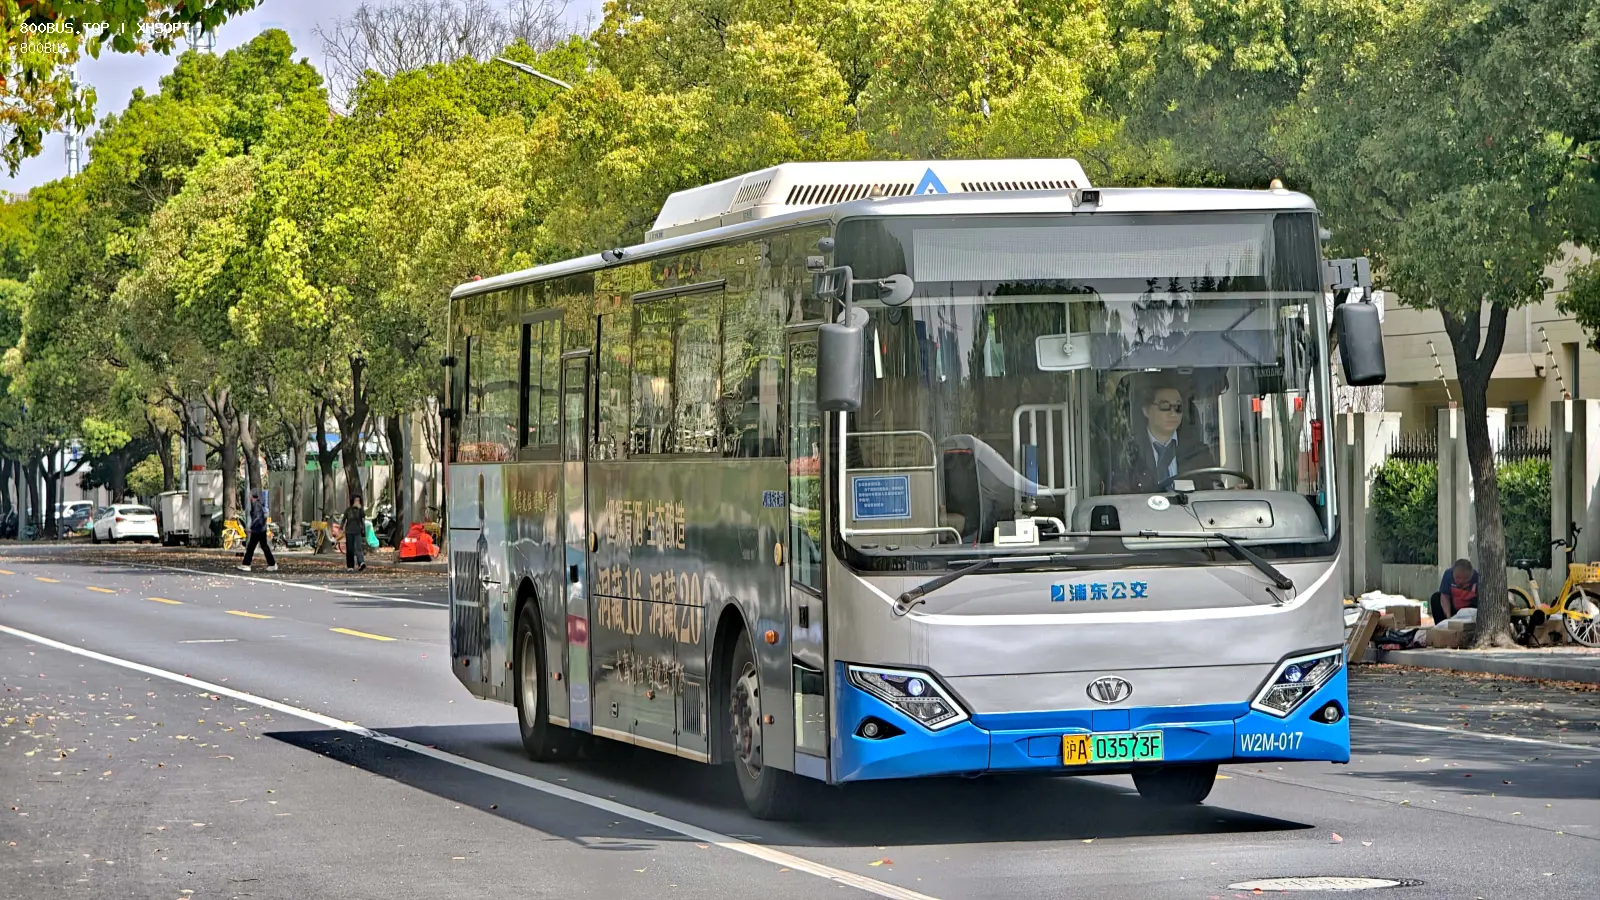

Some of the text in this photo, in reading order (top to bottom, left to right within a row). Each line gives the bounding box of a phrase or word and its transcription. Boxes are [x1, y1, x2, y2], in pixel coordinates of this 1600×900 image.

[1068, 581, 1149, 602] 浦东公交
[596, 563, 702, 646] 洞藏16 洞藏20
[1066, 735, 1160, 761] 沪A 03573F
[1240, 731, 1304, 752] W2M-017
